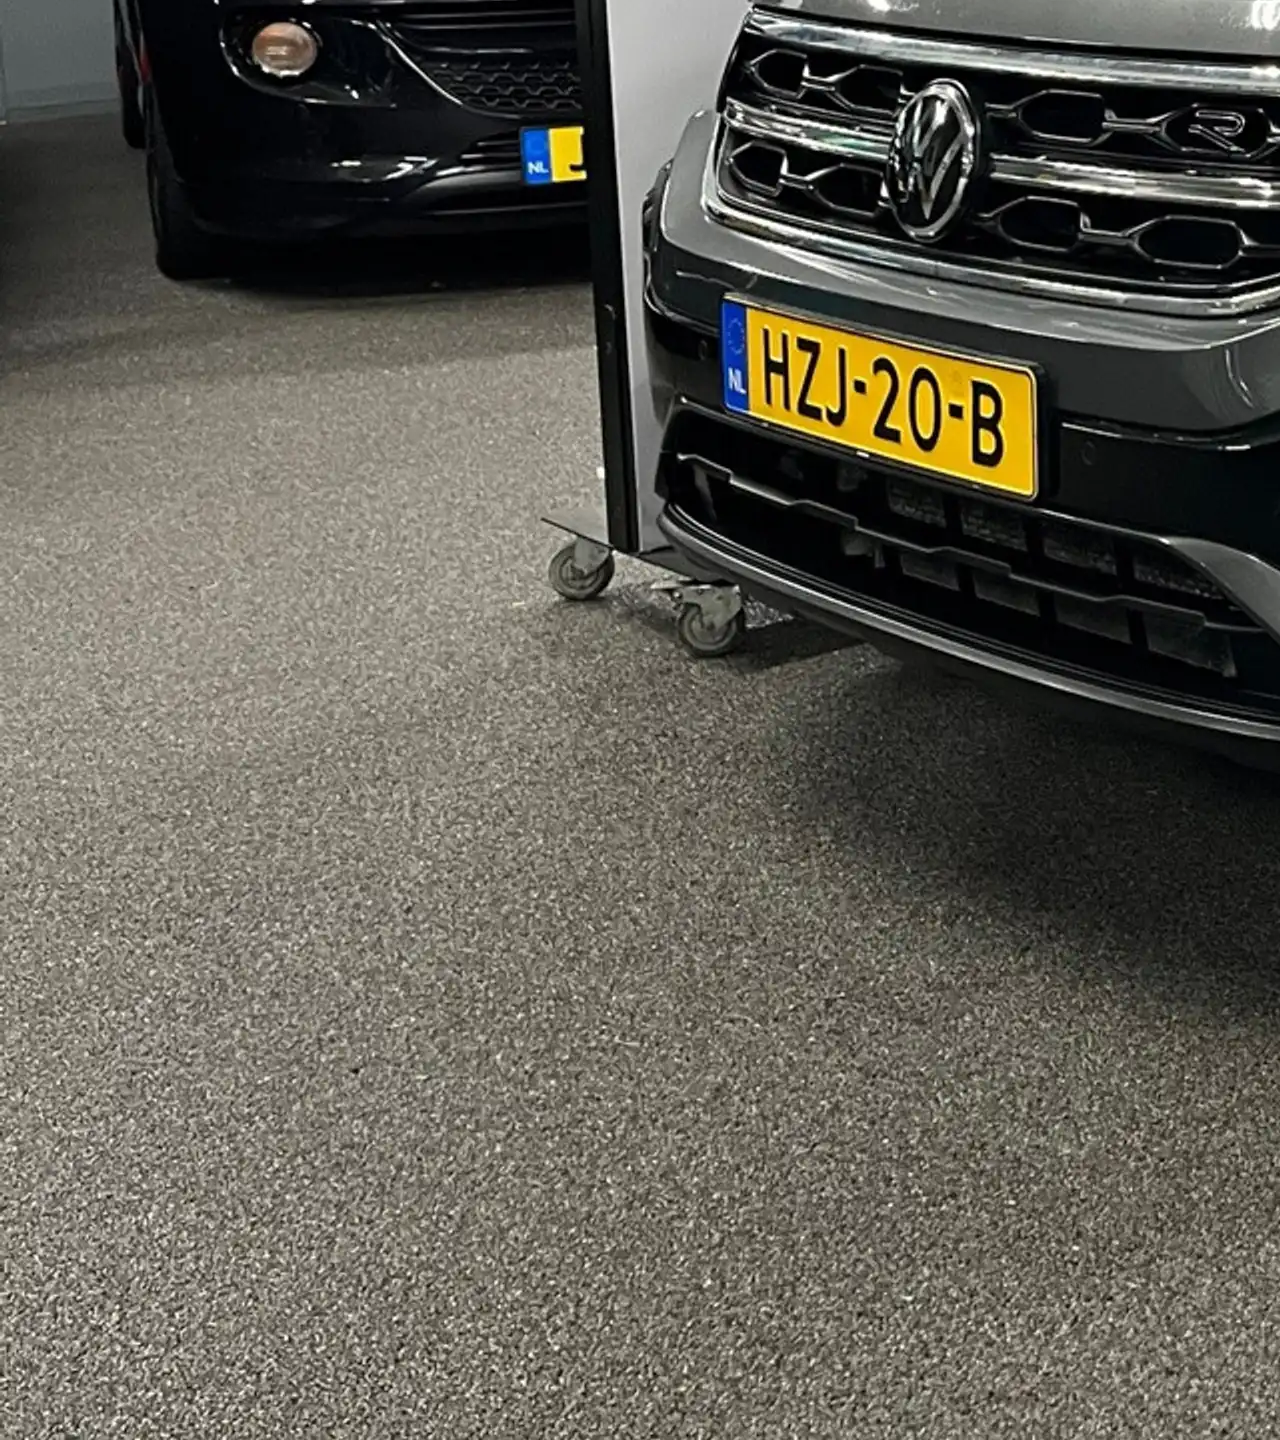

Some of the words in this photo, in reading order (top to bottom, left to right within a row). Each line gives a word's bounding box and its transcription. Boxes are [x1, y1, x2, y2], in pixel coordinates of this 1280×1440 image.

[527, 161, 549, 174] NL
[728, 367, 747, 395] NL
[762, 327, 1005, 468] HZJ-20-B
